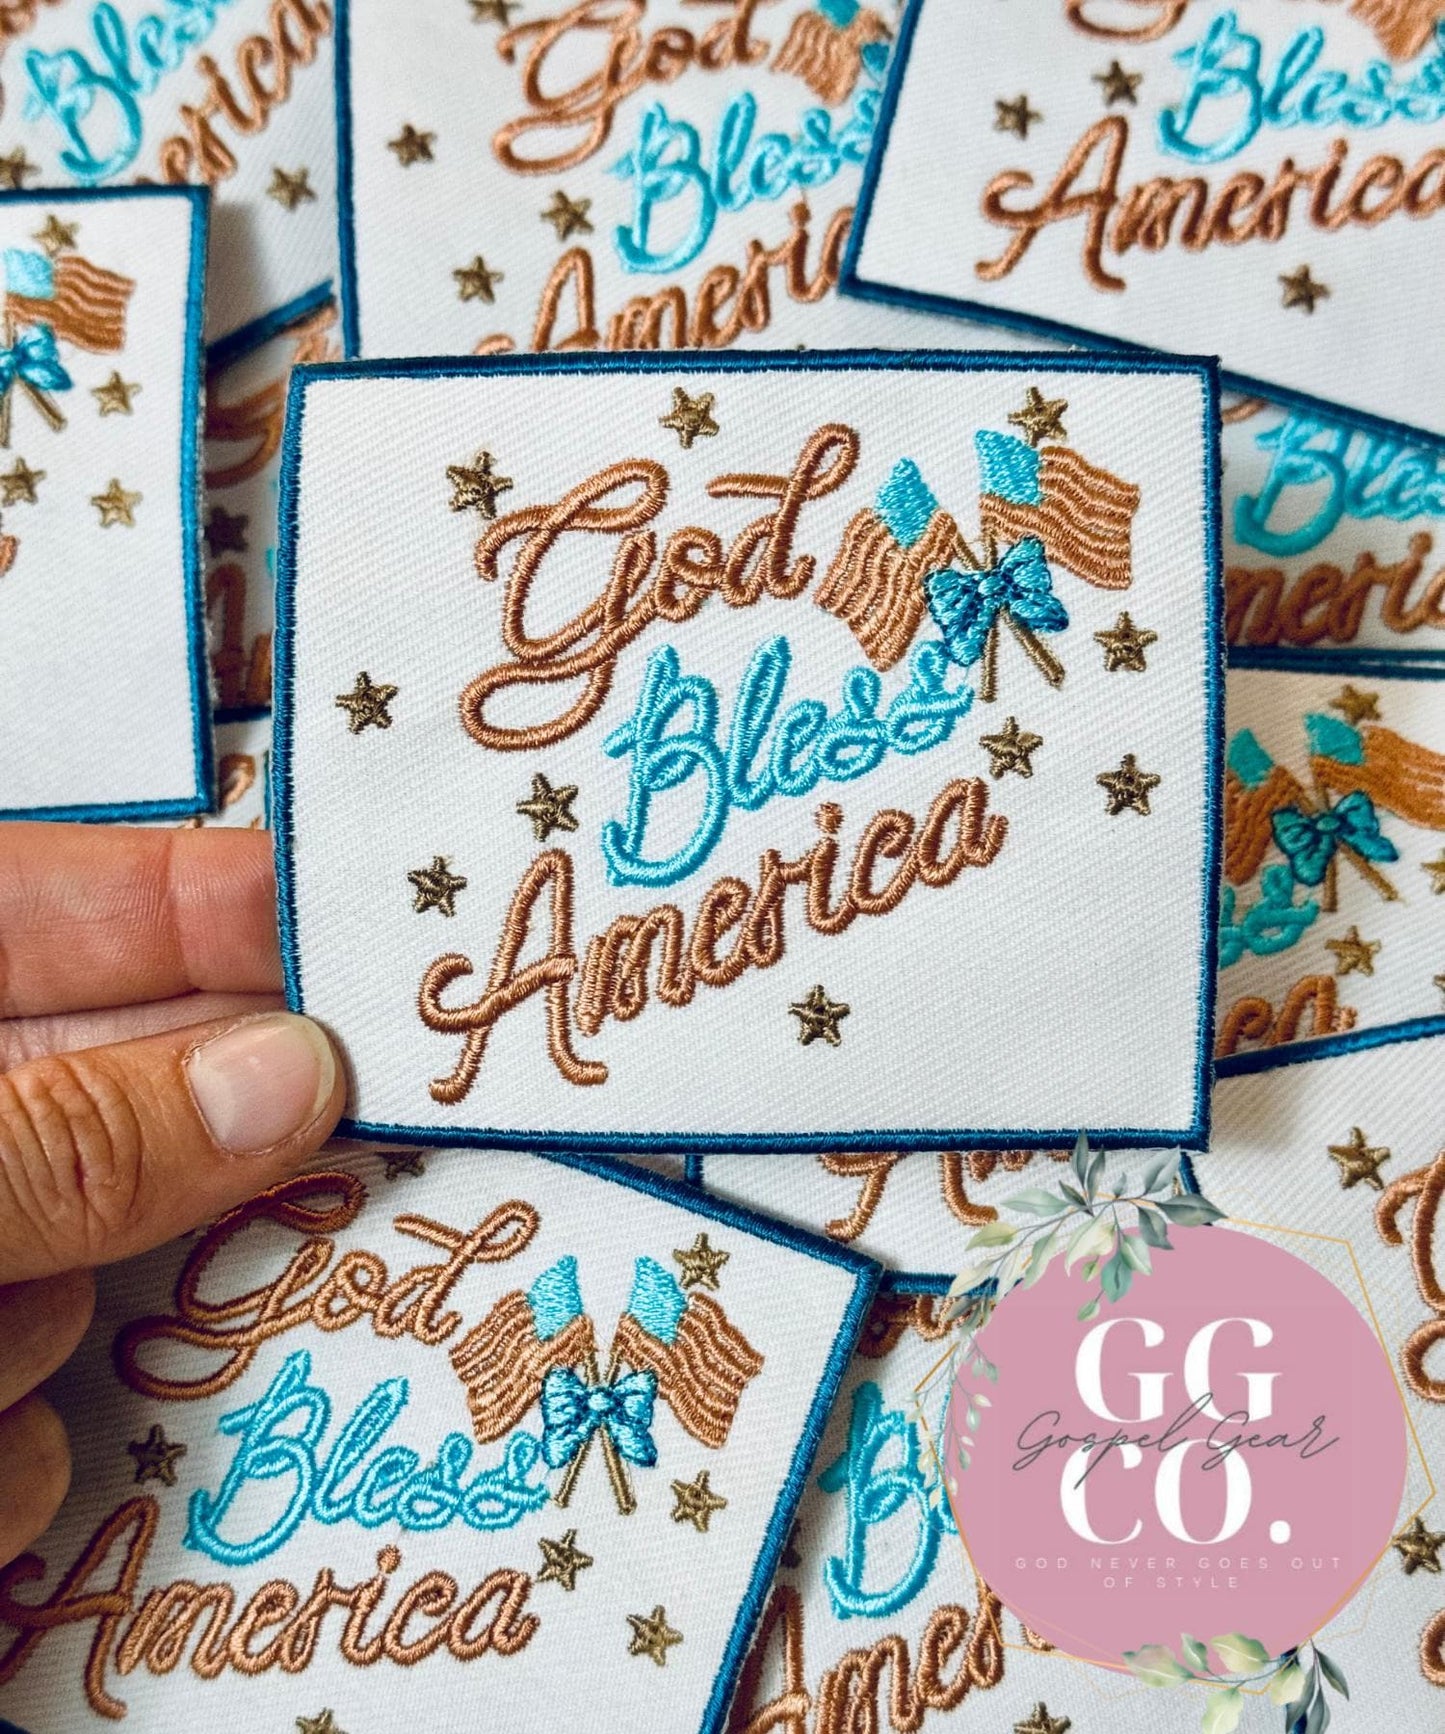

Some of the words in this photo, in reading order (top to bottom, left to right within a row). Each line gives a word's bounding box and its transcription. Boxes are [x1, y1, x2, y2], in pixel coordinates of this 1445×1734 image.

[21, 0, 232, 187] Bles
[137, 0, 332, 188] erica
[491, 0, 770, 175] God
[459, 423, 861, 752] God
[602, 634, 974, 888] Bless
[418, 775, 1009, 1105] America
[112, 1170, 541, 1402] God
[182, 1349, 551, 1566] Bless
[0, 1495, 541, 1720] America
